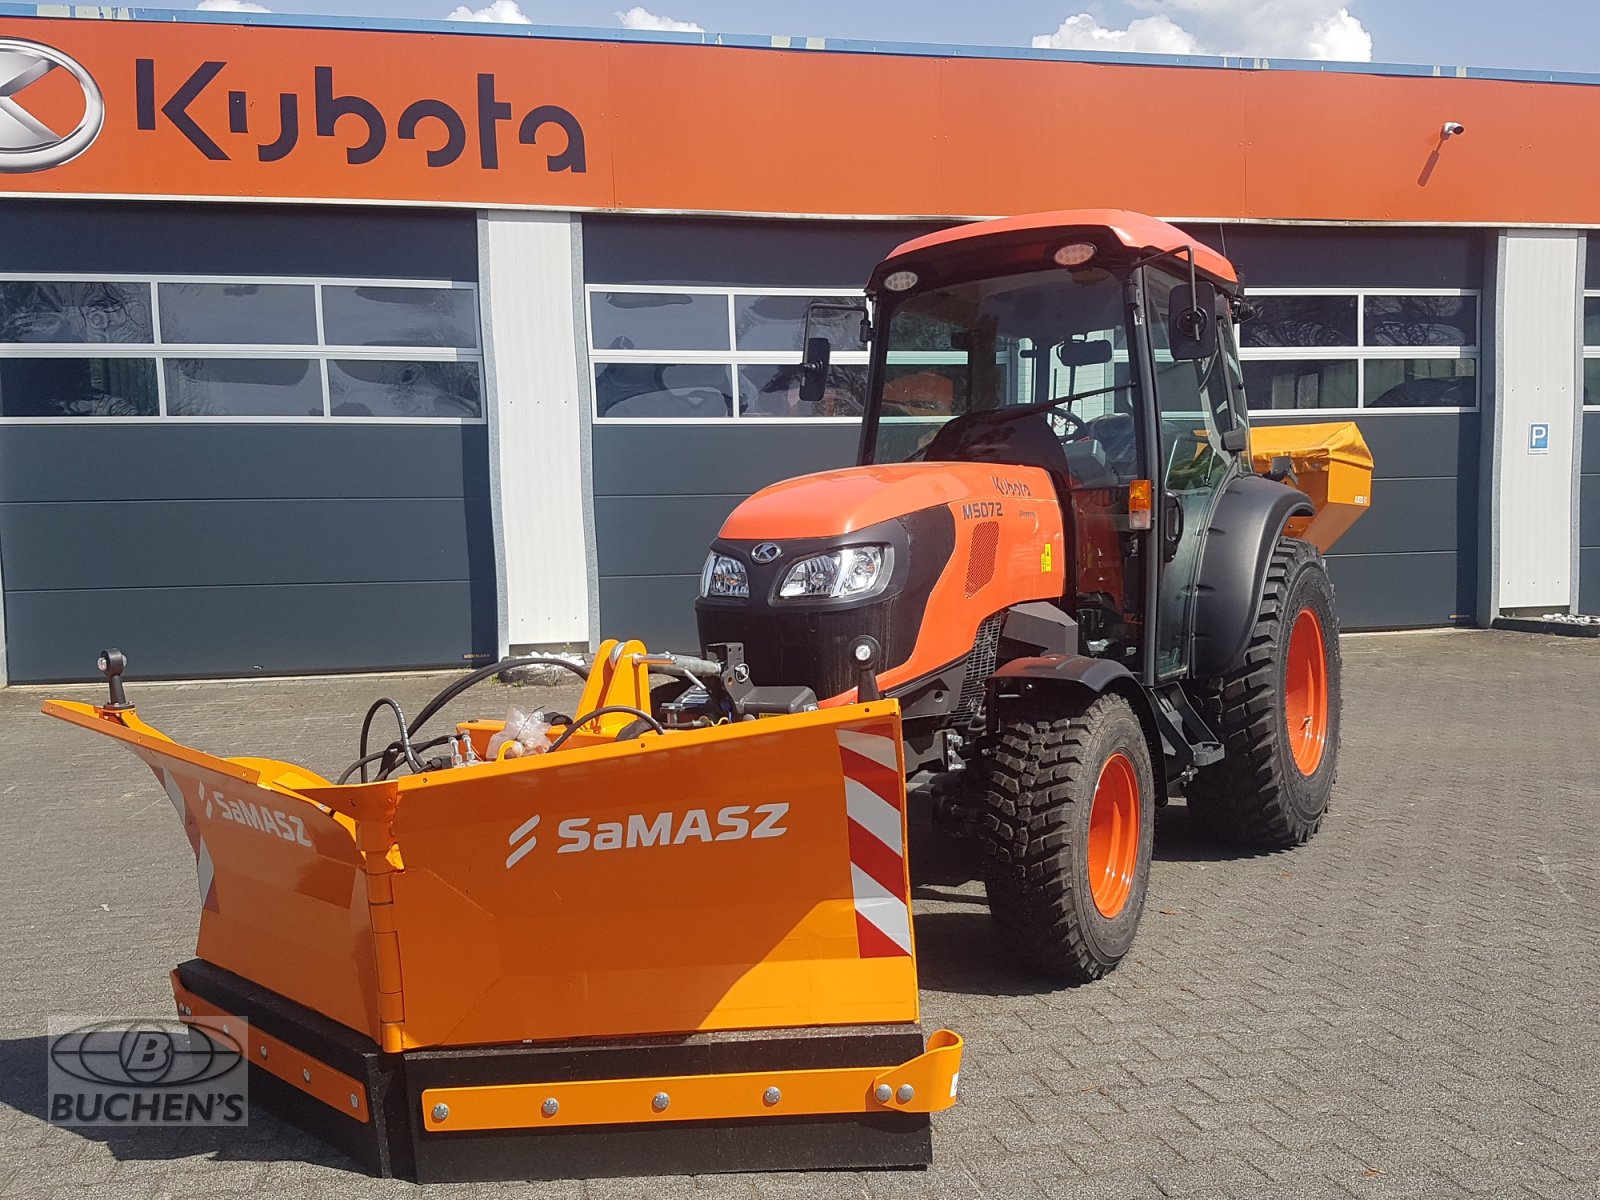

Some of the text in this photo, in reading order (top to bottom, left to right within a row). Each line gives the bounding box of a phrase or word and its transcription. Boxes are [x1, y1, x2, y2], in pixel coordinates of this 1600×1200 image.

[135, 58, 587, 173] Kubota
[1531, 426, 1546, 447] P
[991, 475, 1031, 496] Kubota
[962, 502, 1003, 520] M5072
[213, 791, 312, 847] SaMASZ
[557, 803, 789, 853] SaMASZ
